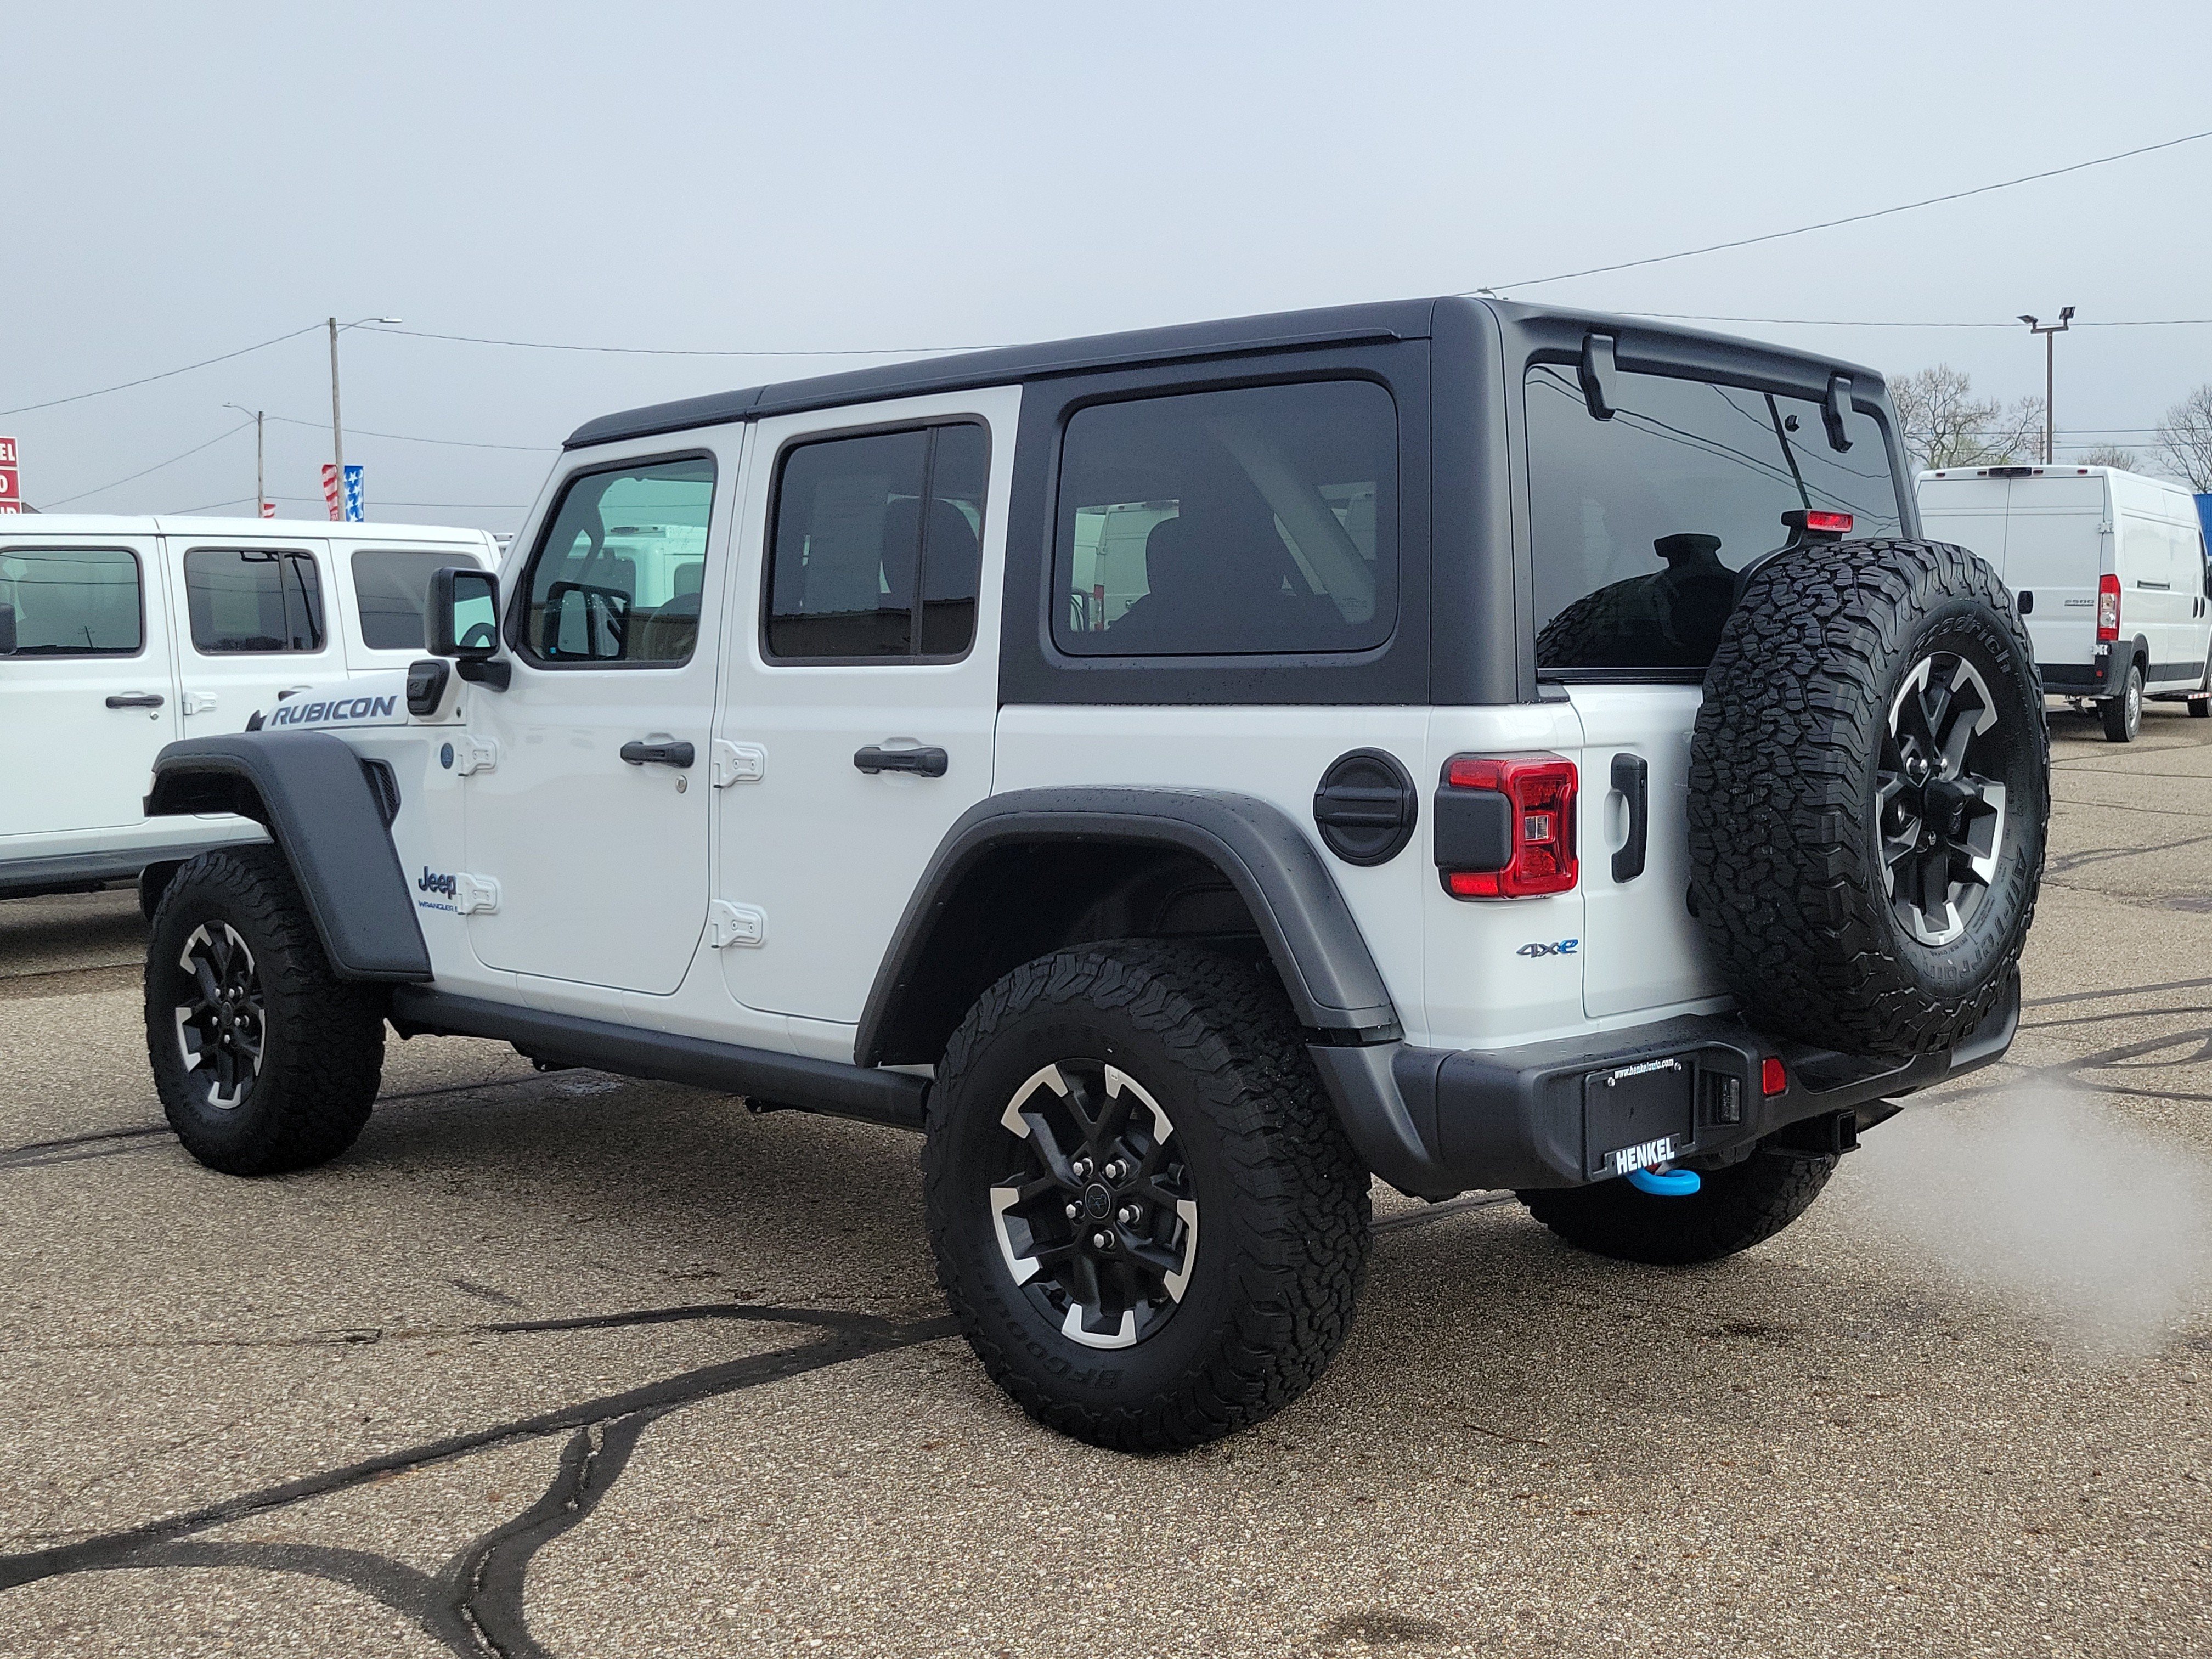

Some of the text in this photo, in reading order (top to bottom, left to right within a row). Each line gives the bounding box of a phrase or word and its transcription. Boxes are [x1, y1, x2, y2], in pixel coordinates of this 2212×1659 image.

[271, 695, 398, 726] RUBICON
[418, 866, 456, 900] Jeep
[418, 900, 454, 911] WRANGLER
[1516, 939, 1578, 958] 4xe
[1615, 1058, 1674, 1079] www.henkelauto.com
[1616, 1137, 1675, 1175] HENKEL
